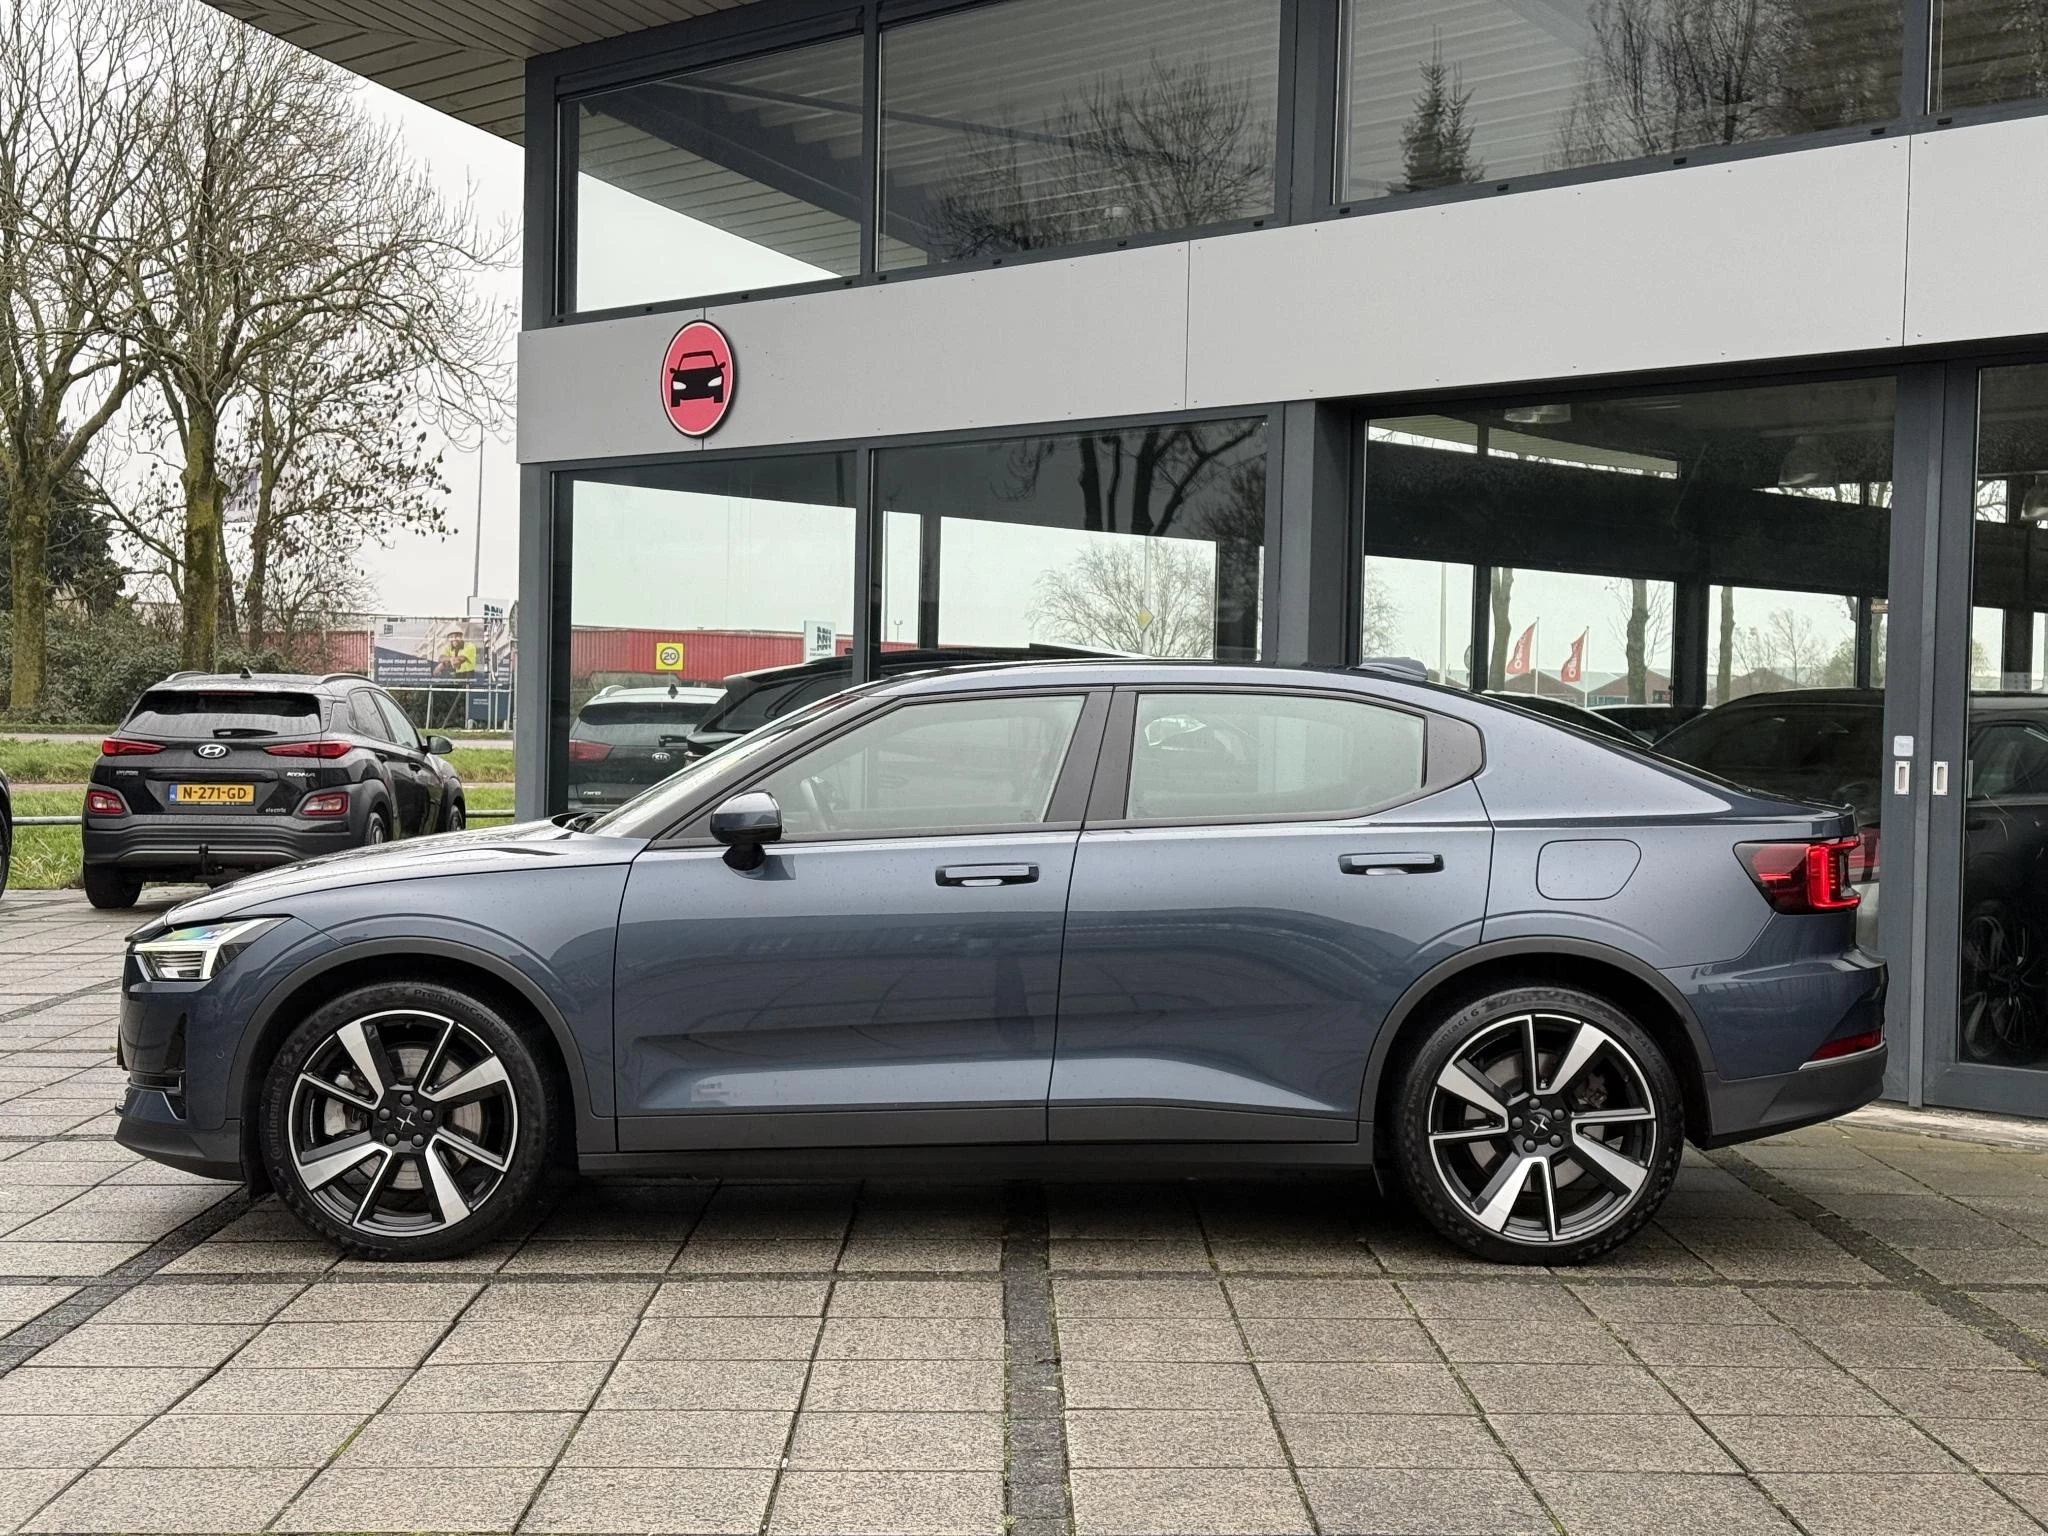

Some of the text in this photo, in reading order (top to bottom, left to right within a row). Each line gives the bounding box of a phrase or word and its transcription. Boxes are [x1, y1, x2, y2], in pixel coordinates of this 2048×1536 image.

[663, 652, 677, 660] 20
[183, 787, 246, 800] N-271-GD
[1471, 1008, 1480, 1017] 6
[266, 1088, 284, 1160] Continental
